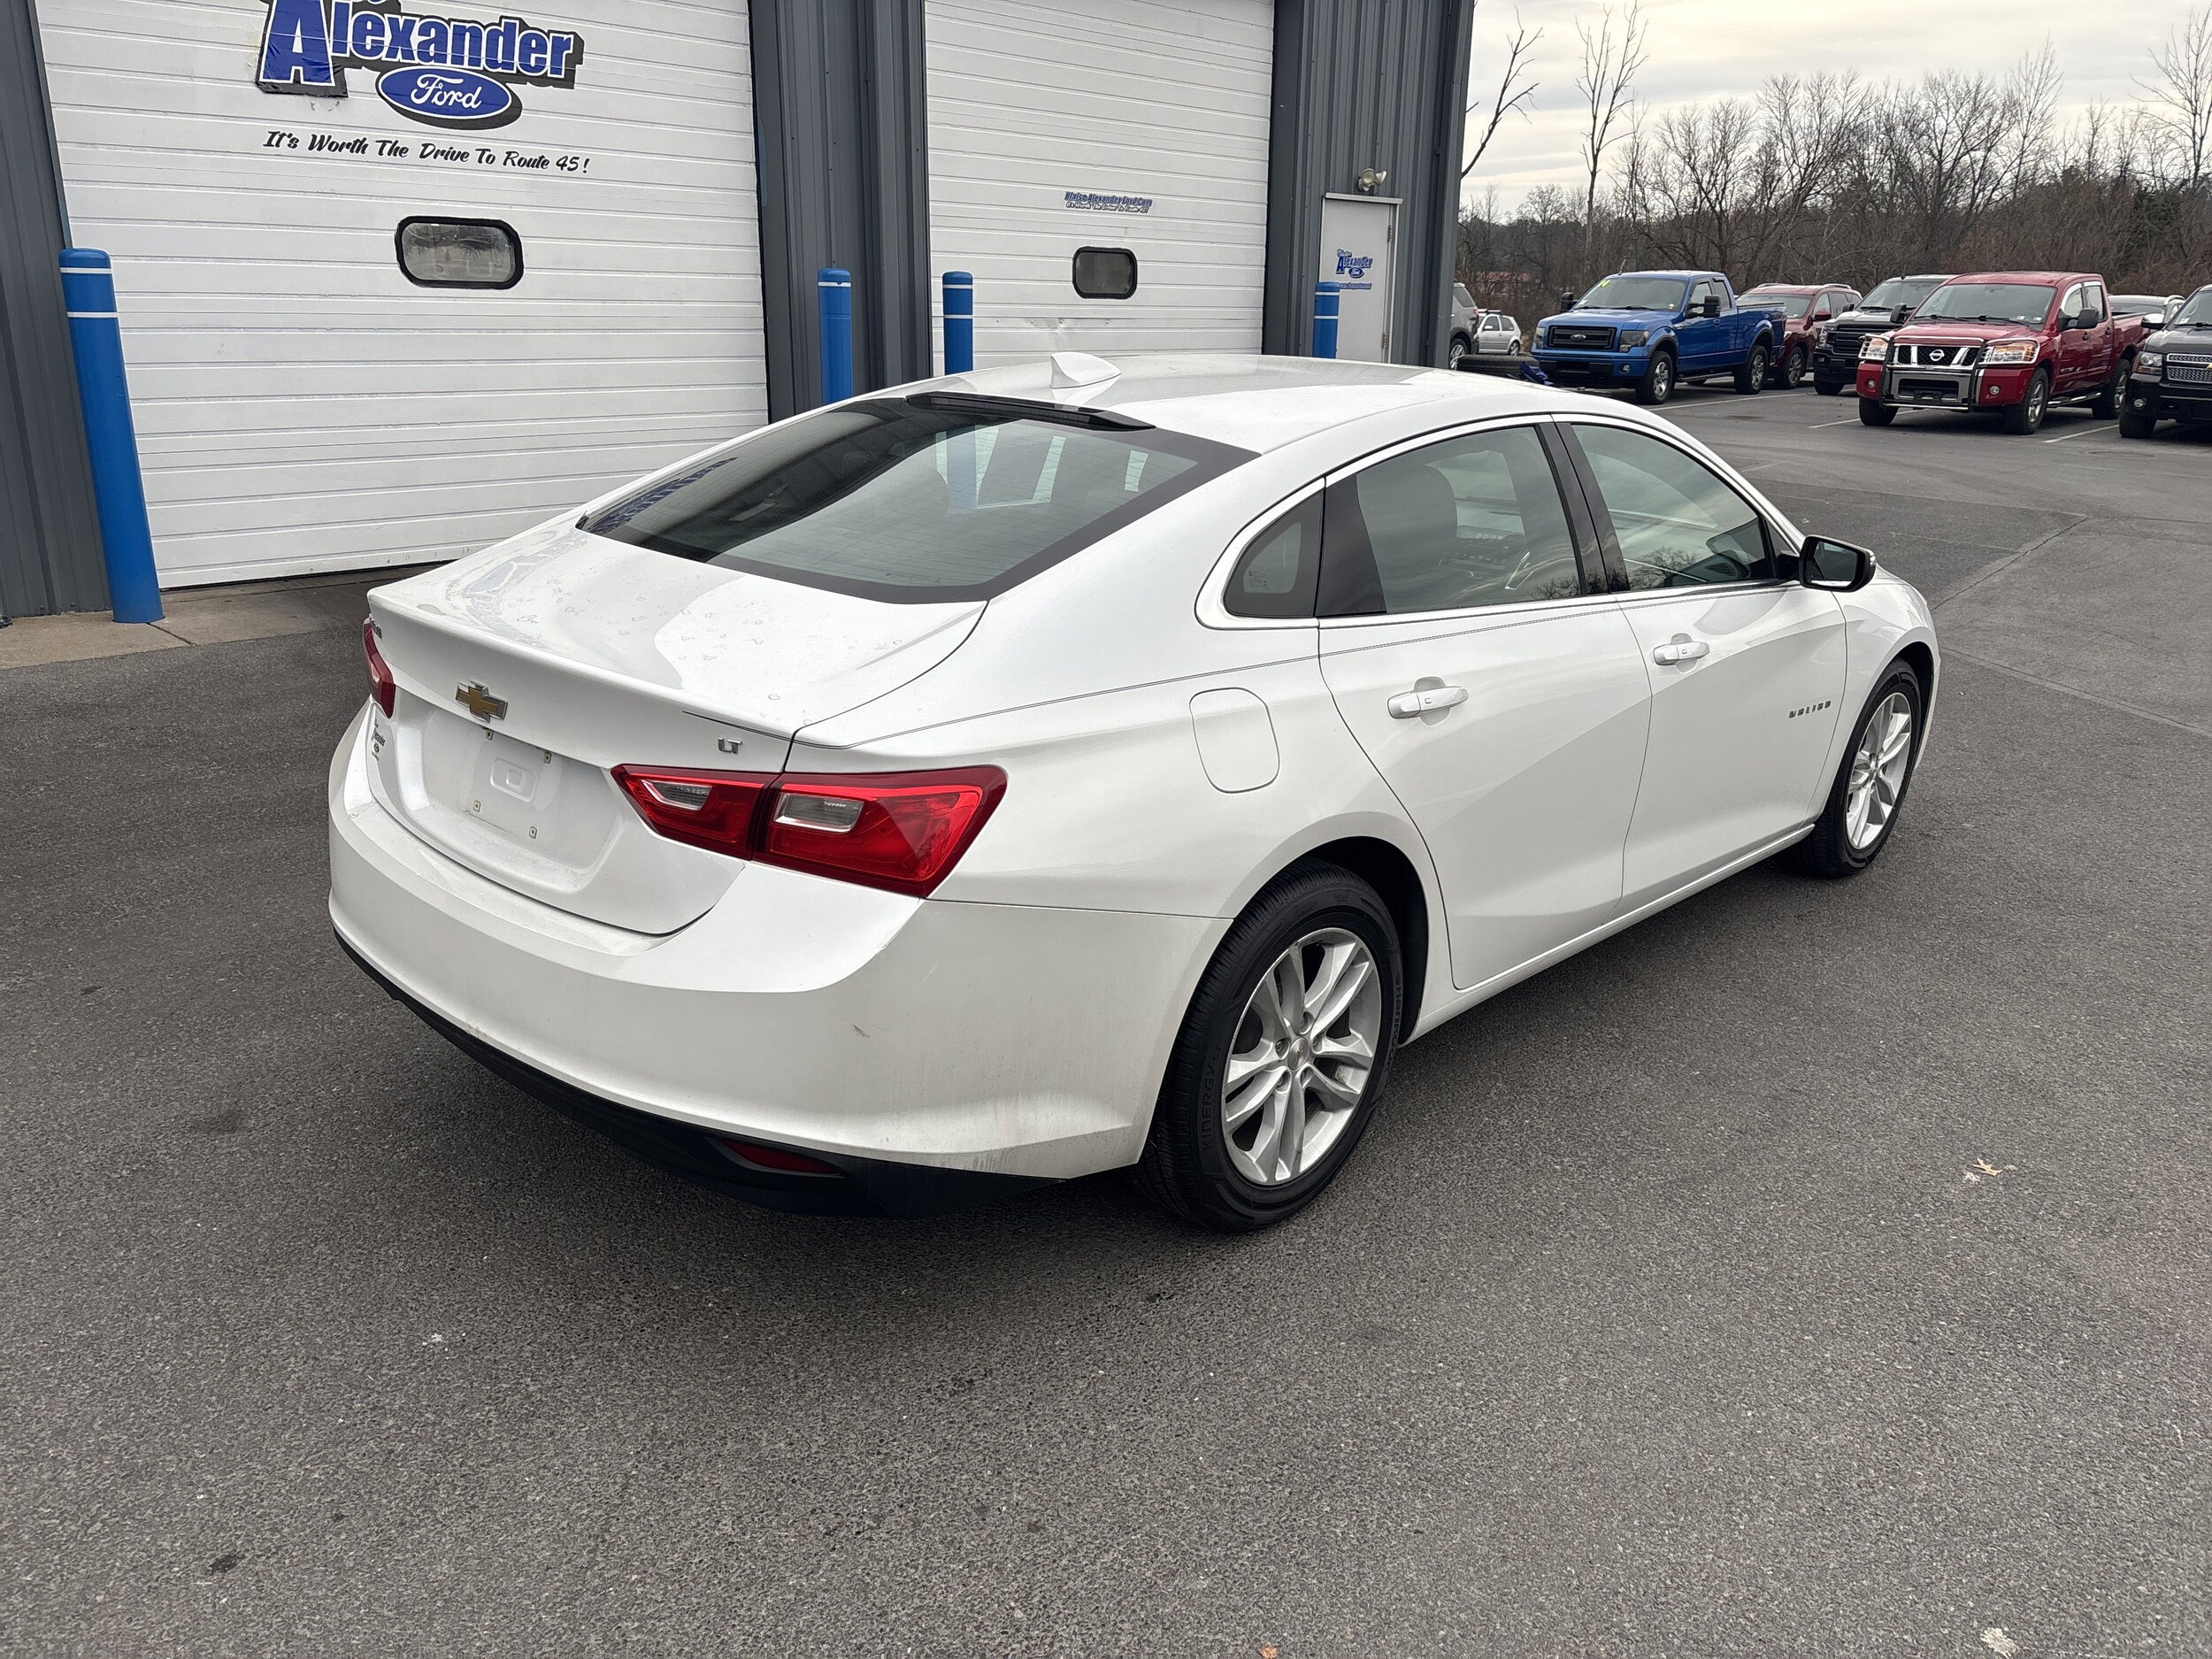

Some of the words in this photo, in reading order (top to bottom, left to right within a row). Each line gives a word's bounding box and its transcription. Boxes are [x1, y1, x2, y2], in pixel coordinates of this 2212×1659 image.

[259, 0, 575, 87] Alexander
[410, 74, 482, 110] Ford
[263, 130, 299, 150] It's
[307, 134, 369, 155] Worth
[374, 139, 410, 157] The
[419, 142, 470, 163] Drive
[474, 148, 496, 165] To
[503, 150, 550, 170] Route
[718, 737, 743, 755] LT
[1202, 1064, 1216, 1150] KINERGY
